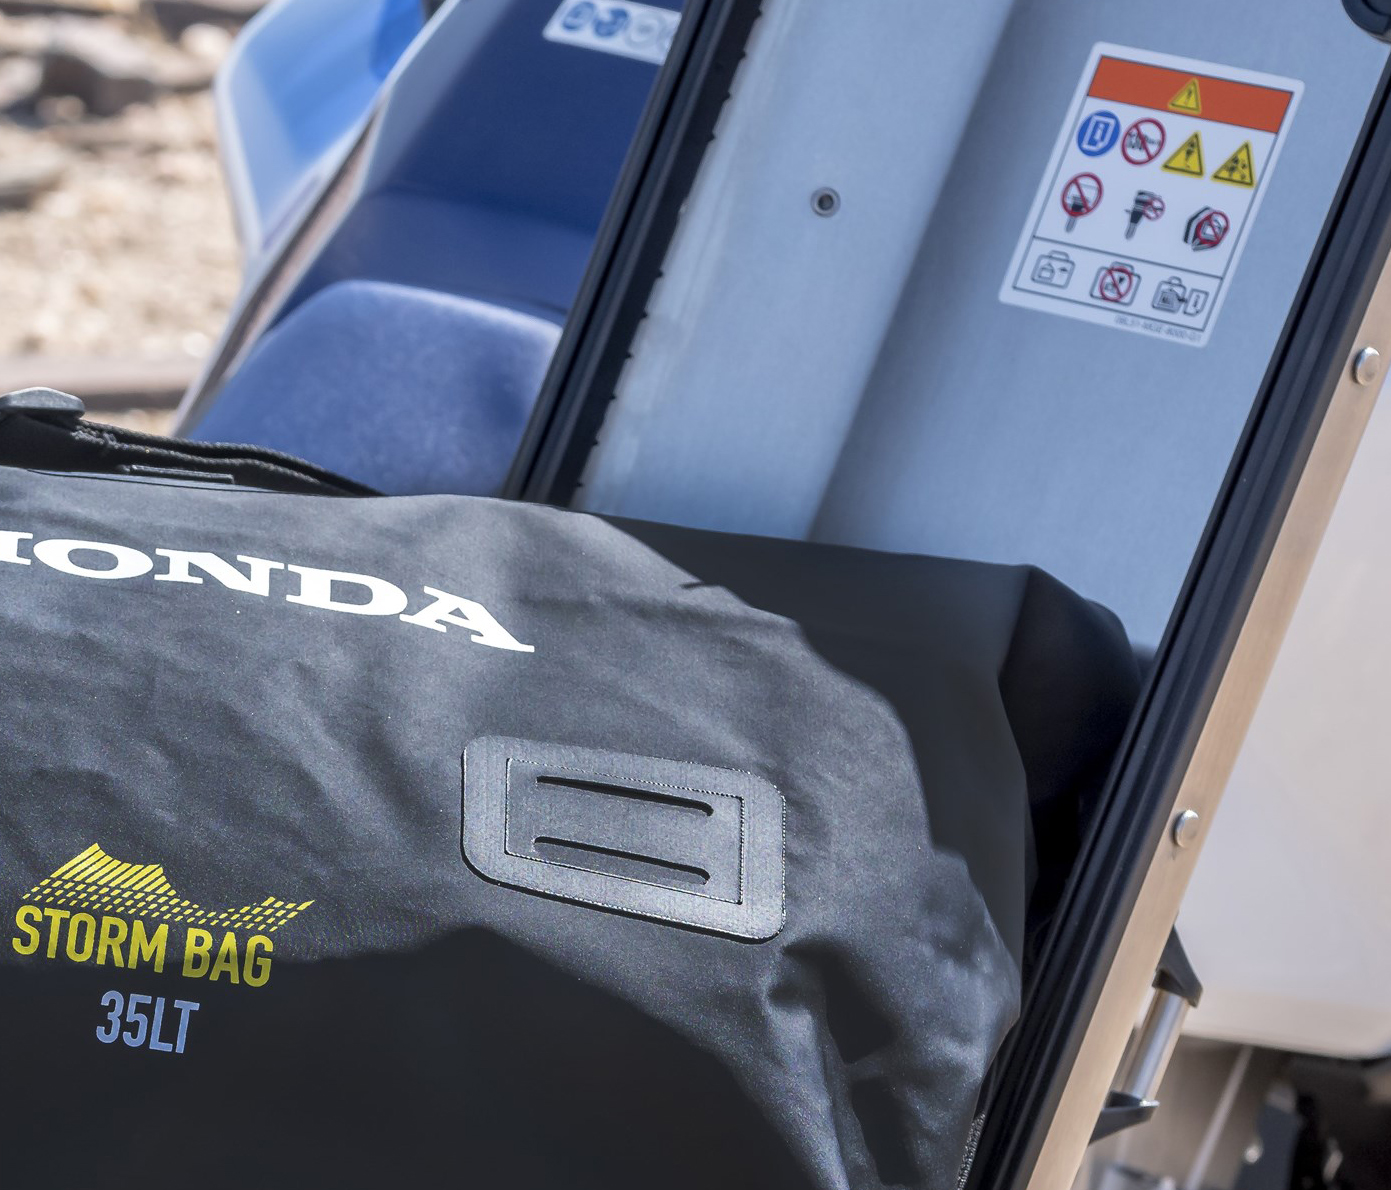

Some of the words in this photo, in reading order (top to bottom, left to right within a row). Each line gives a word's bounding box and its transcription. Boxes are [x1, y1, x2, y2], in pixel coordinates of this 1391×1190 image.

[12, 904, 169, 975] STORM
[182, 927, 275, 987] BAG
[95, 989, 200, 1054] 35LT
